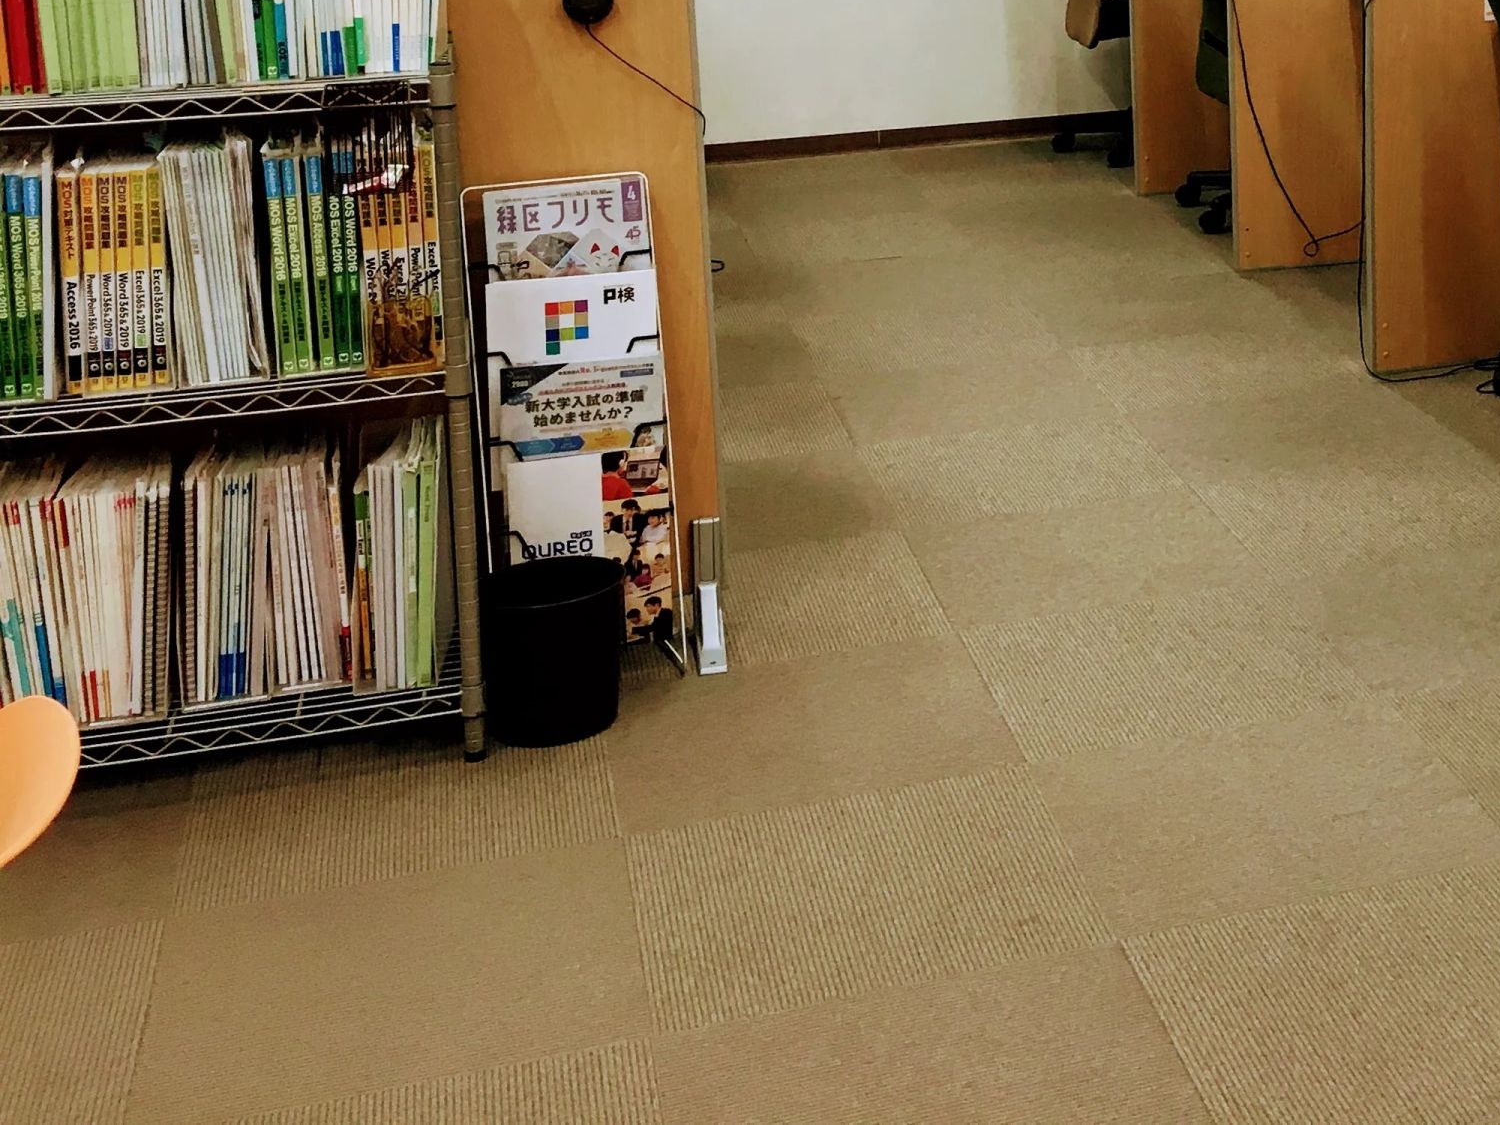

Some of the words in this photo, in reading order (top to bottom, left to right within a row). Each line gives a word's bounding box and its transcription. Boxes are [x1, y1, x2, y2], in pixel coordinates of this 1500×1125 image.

[626, 186, 636, 200] 4
[269, 200, 281, 226] MOS
[311, 196, 322, 221] MOS
[496, 197, 615, 234] 緑区フリモ
[9, 216, 21, 242] MOS
[28, 218, 39, 246] MOS
[272, 226, 284, 255] Word
[331, 220, 341, 247] Excel
[12, 243, 23, 270] Word
[274, 256, 286, 281] 2016
[333, 249, 343, 273] 2016
[102, 273, 112, 297] Word
[118, 273, 129, 300] Word
[153, 269, 164, 296] Excel
[66, 281, 77, 320] Access
[120, 300, 129, 319] 365
[154, 296, 164, 314] 365
[69, 321, 80, 350] 2016
[104, 319, 113, 337] 2019
[120, 327, 129, 348] 2019
[155, 321, 165, 343] 2019
[525, 389, 645, 413] 新大学入試の準備
